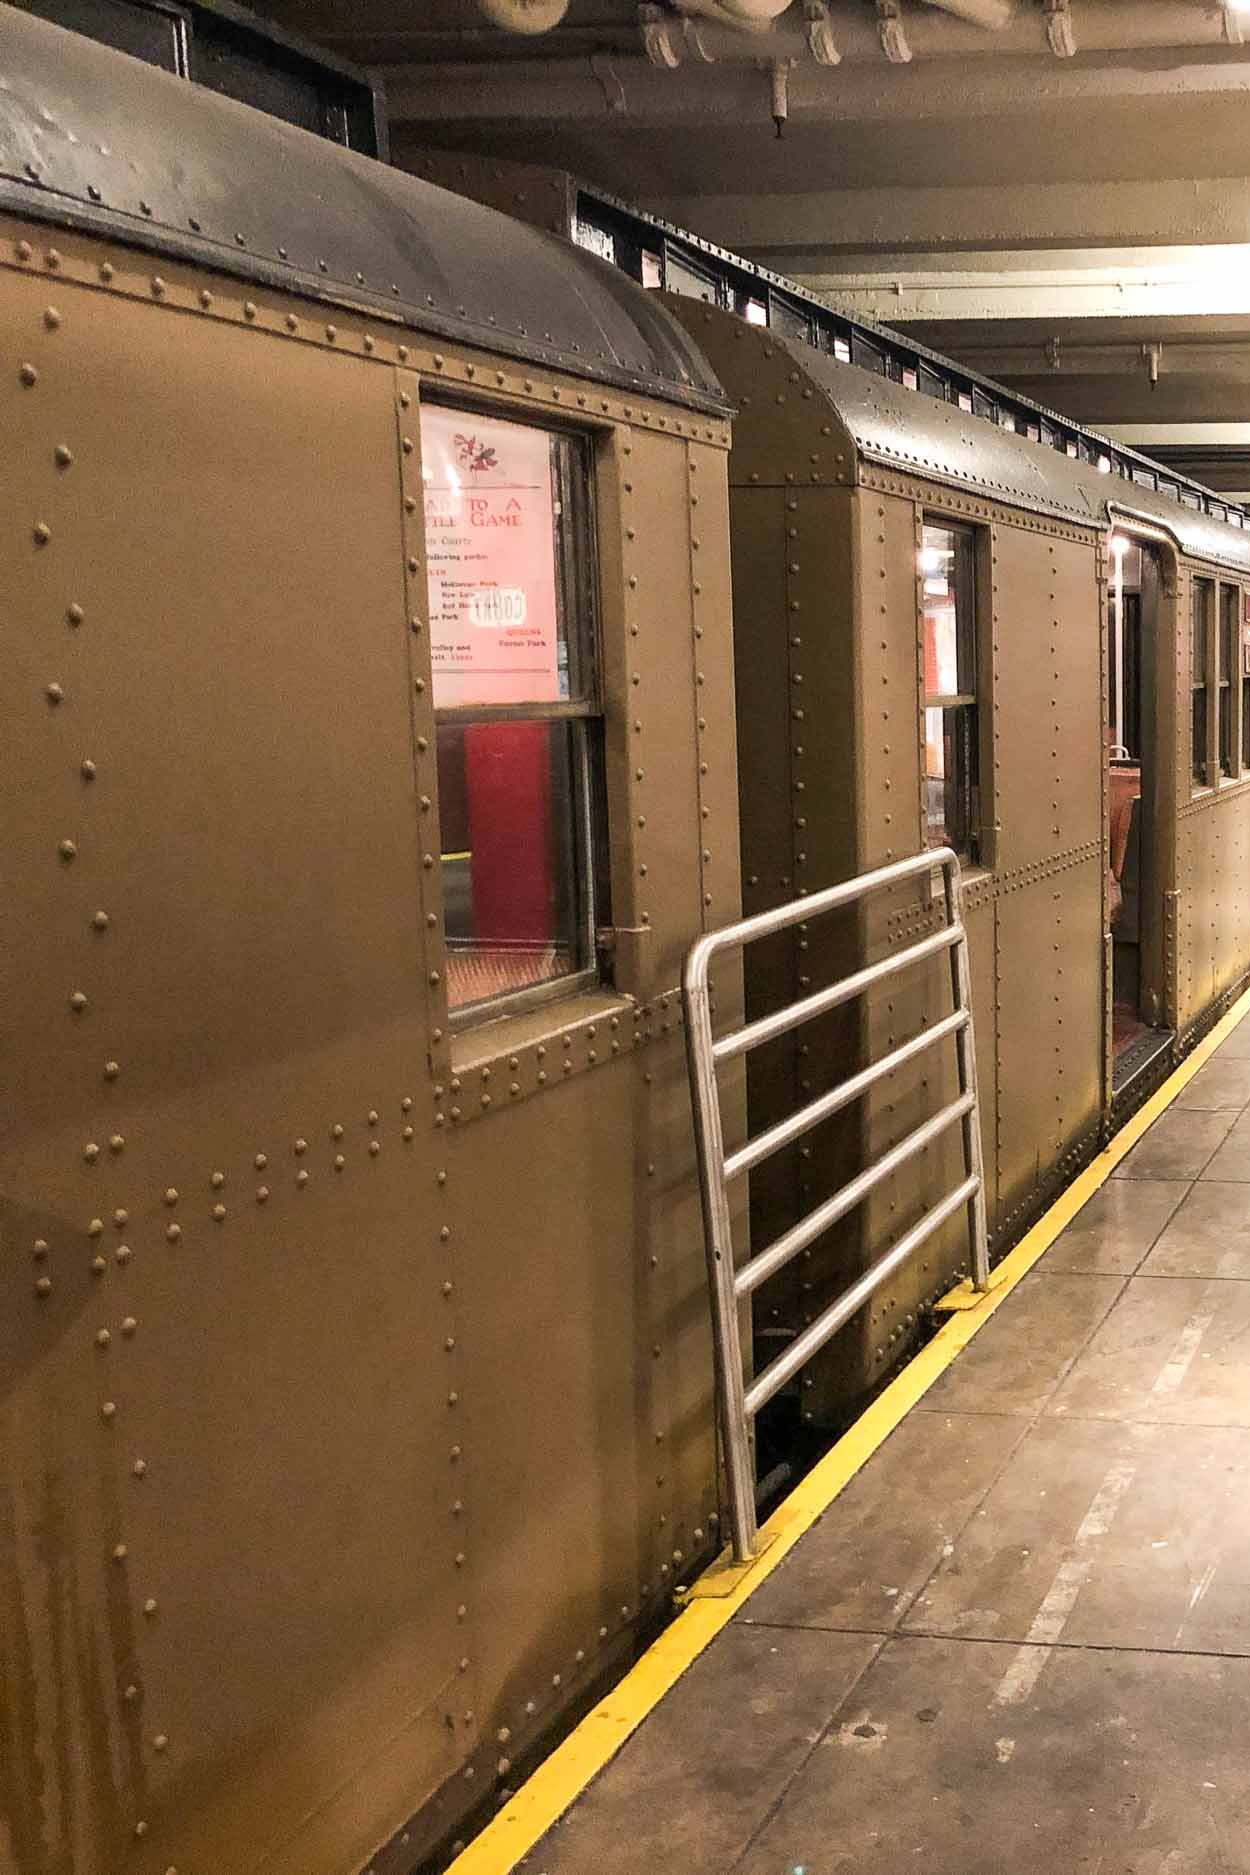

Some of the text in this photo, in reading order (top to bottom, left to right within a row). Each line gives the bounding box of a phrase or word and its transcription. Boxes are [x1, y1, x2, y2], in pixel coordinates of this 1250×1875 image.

[470, 498, 489, 511] TO
[505, 496, 523, 511] A
[470, 511, 522, 527] GAME
